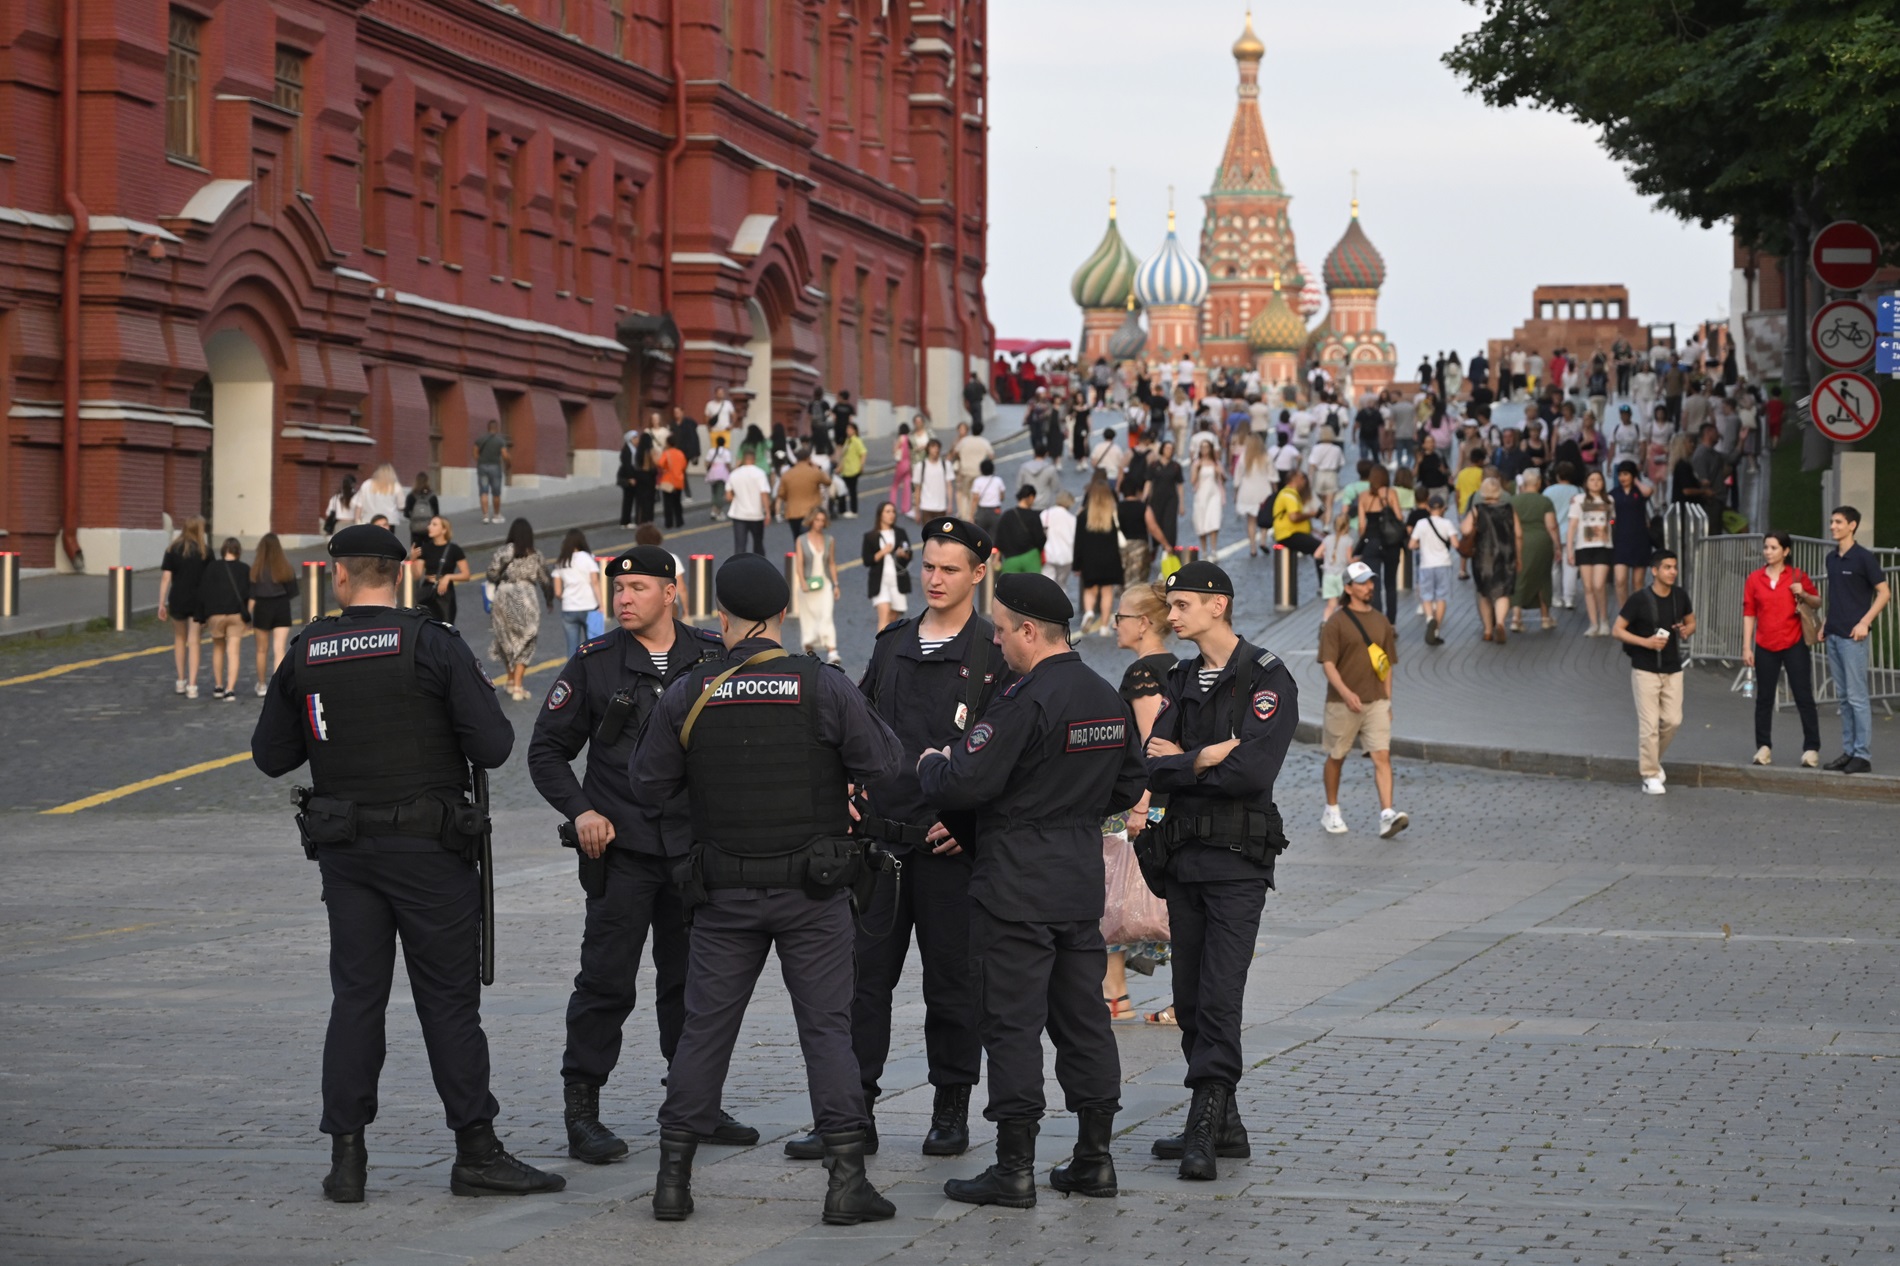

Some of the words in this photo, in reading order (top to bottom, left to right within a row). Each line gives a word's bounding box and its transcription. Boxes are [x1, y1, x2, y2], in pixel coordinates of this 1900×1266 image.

[309, 640, 338, 657] МВД
[341, 633, 398, 652] РОССИИ
[736, 680, 798, 695] РОССИИ
[1070, 729, 1088, 746] МВД
[1089, 725, 1124, 742] РОССИИ
